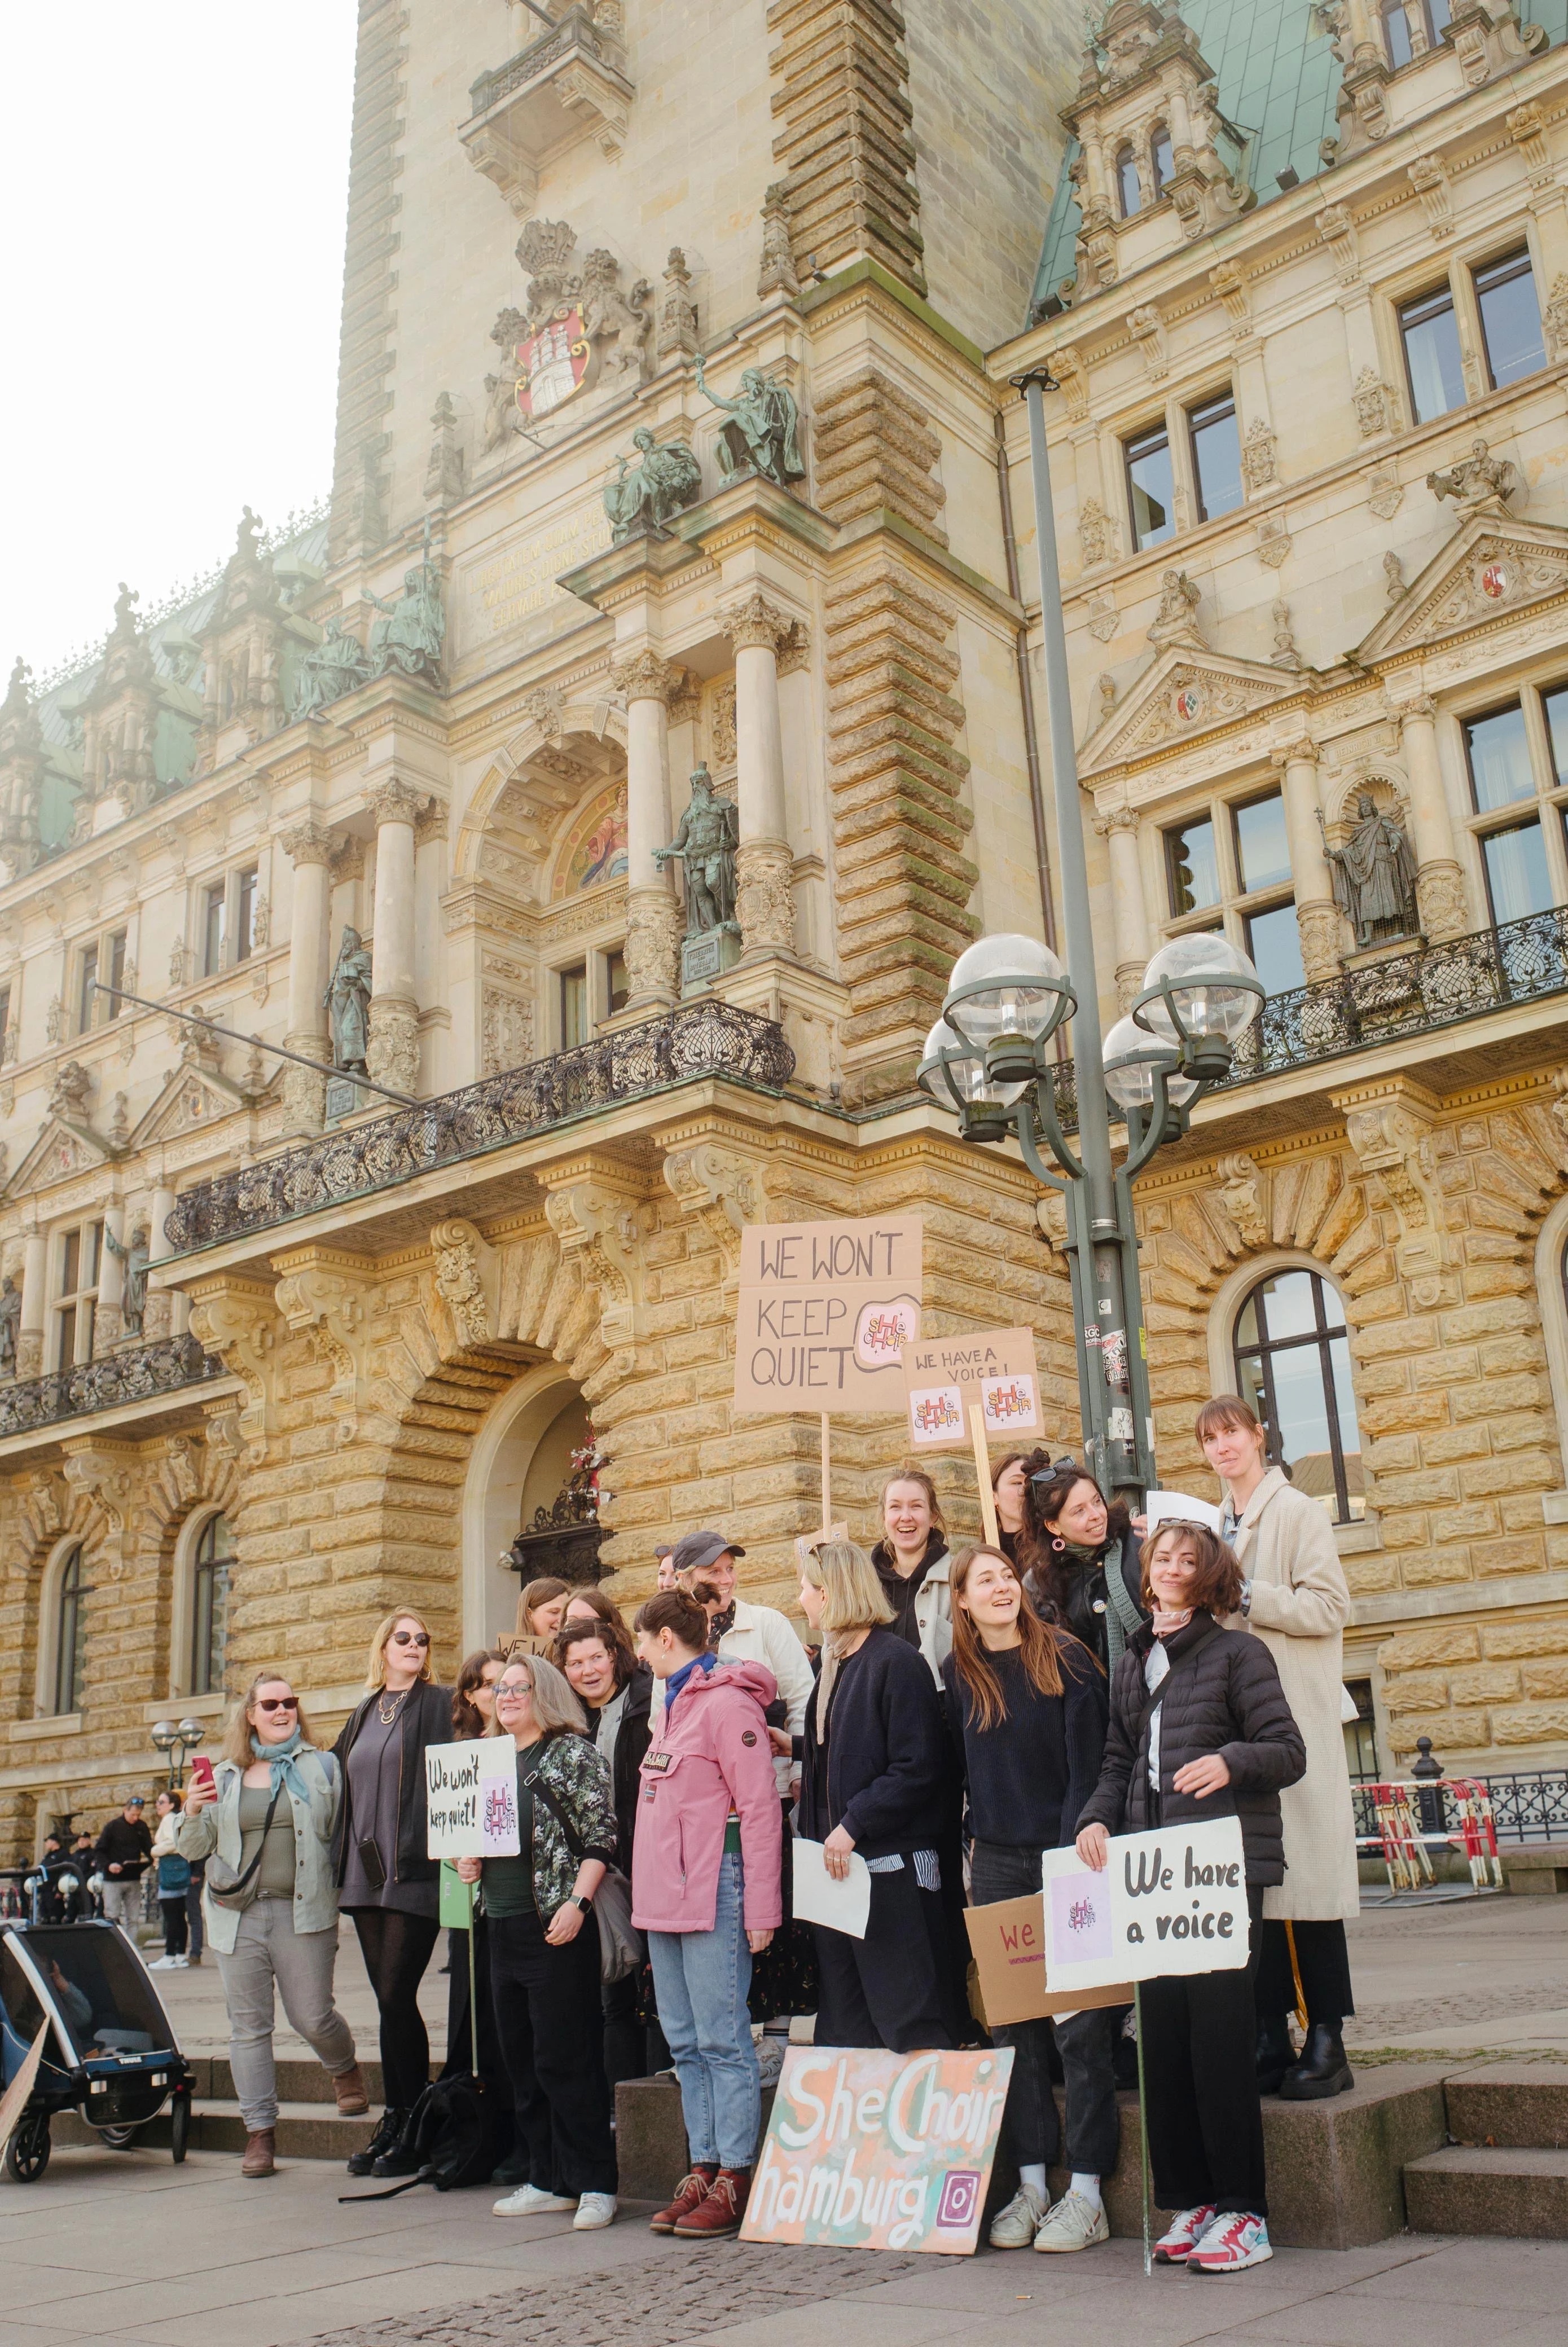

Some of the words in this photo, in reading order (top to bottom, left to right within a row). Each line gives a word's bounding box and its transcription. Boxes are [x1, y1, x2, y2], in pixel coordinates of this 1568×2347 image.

[760, 1236, 803, 1280] WE
[812, 1230, 903, 1280] WON'T
[757, 1298, 847, 1340] KEEP
[751, 1346, 854, 1389] QUIET
[916, 1355, 937, 1371] WE
[942, 1350, 982, 1369] HAVE
[984, 1347, 998, 1361] A
[429, 1758, 448, 1793] We
[451, 1753, 479, 1791] won't
[430, 1807, 447, 1838] keep
[449, 1794, 476, 1834] quiet!
[1125, 1847, 1174, 1897] We
[1184, 1845, 1240, 1889] have
[999, 1923, 1036, 1952] We
[1127, 1922, 1145, 1944] a
[1156, 1900, 1233, 1941] voice
